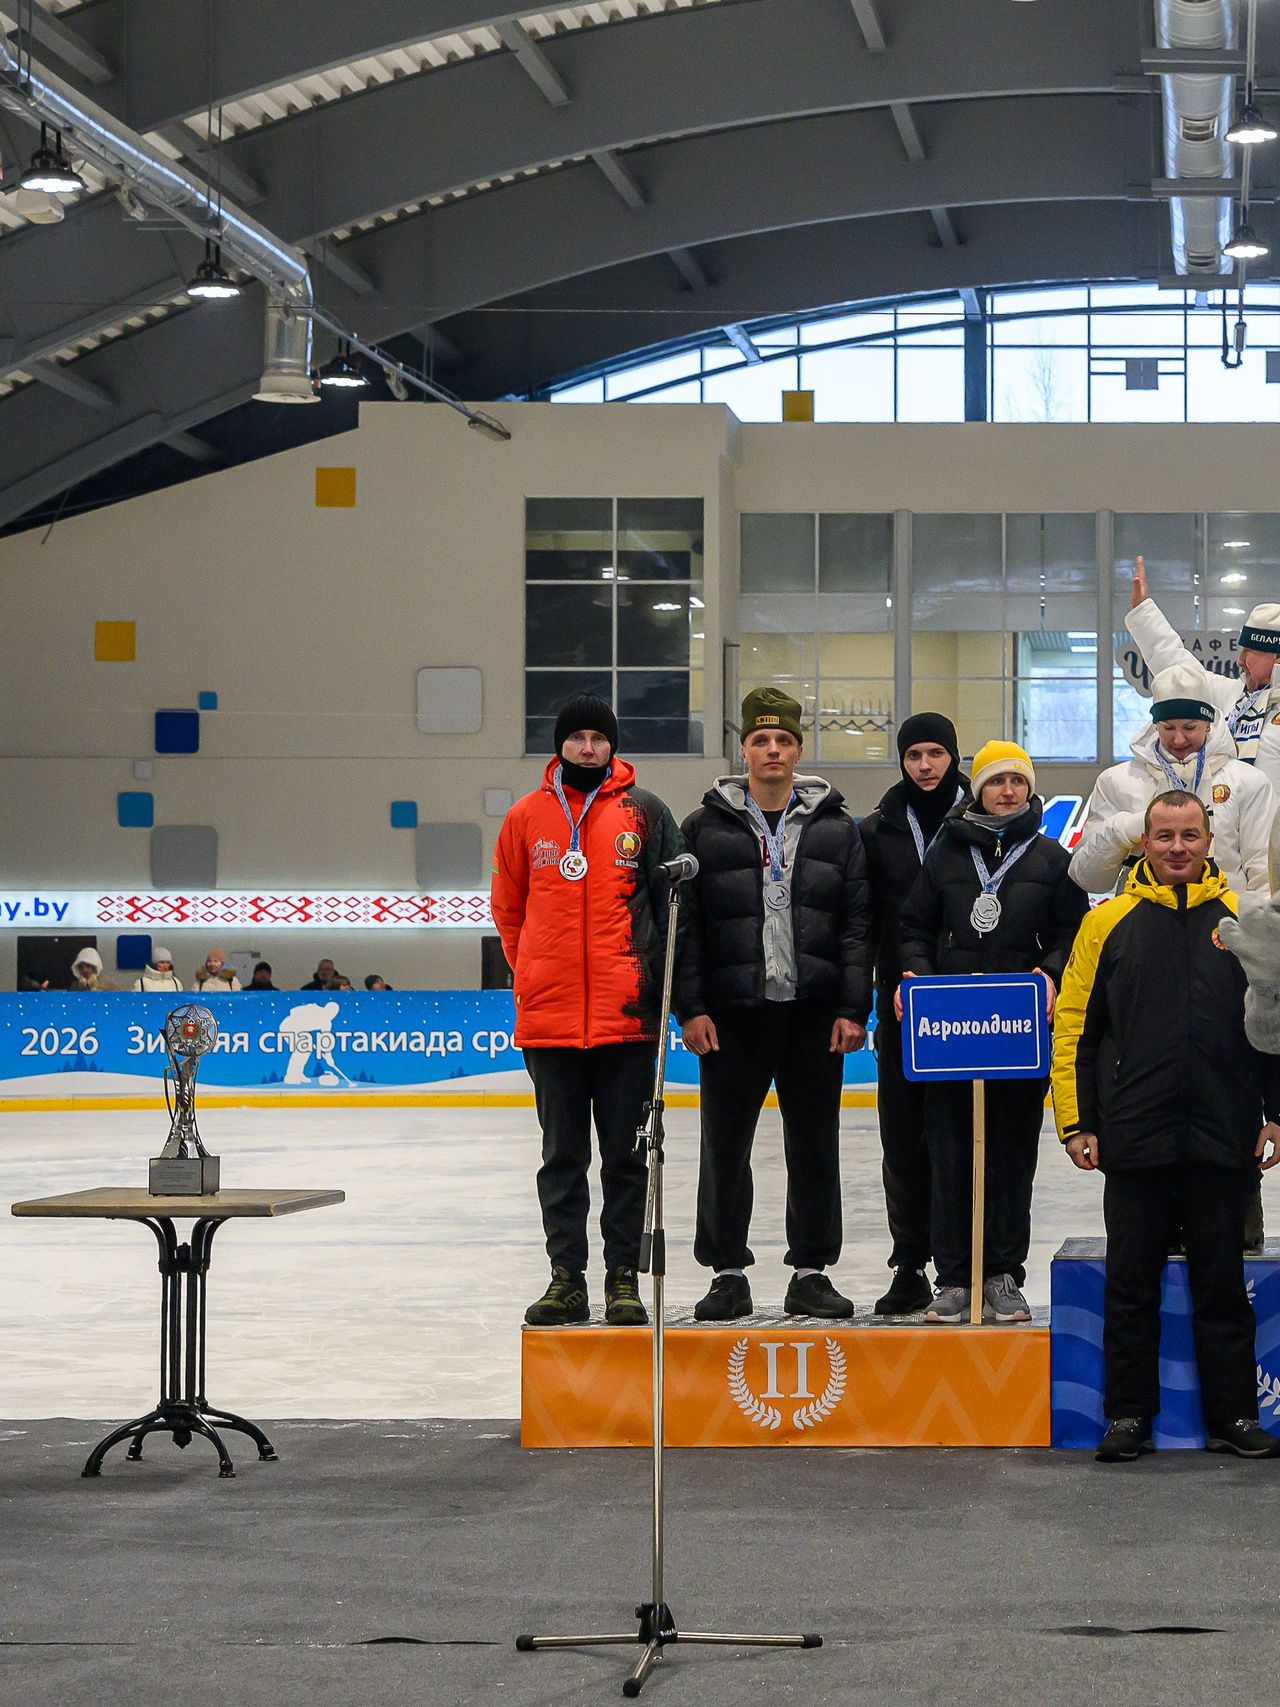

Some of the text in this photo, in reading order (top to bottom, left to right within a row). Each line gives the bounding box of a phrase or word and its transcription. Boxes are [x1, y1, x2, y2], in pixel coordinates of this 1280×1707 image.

[1181, 638, 1237, 651] АФЕ
[0, 897, 69, 921] y.by
[918, 1014, 1032, 1041] Агрохолдинг
[21, 1027, 99, 1055] 2026
[127, 1025, 249, 1054] Зияя
[258, 1031, 463, 1060] спартакиада
[759, 1342, 815, 1398] II
